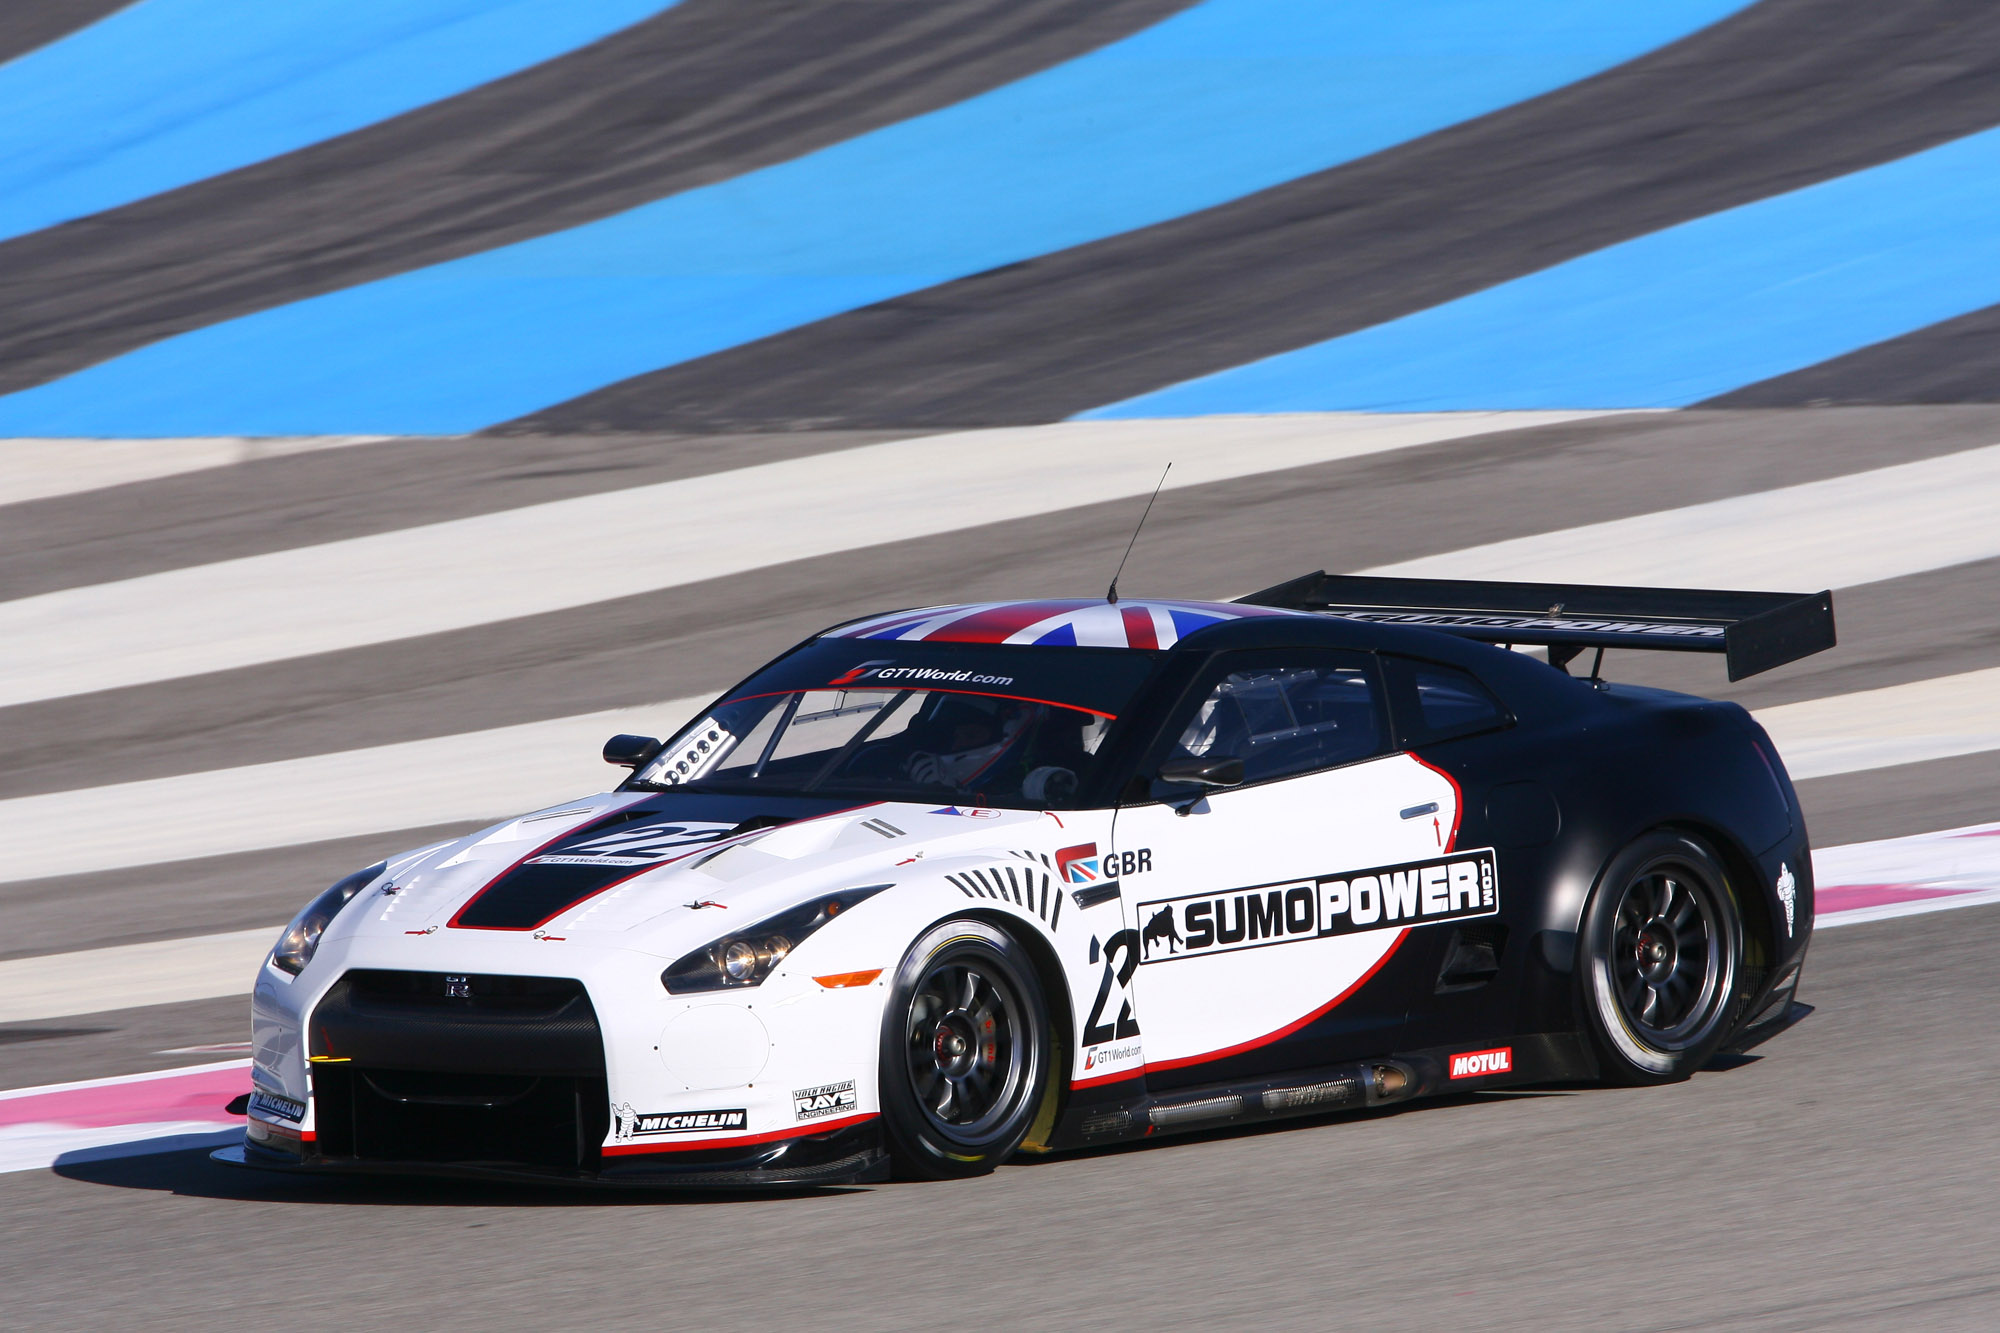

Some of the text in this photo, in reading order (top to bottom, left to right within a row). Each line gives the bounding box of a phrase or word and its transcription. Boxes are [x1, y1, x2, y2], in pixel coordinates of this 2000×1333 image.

[878, 668, 1013, 686] GT1World.com
[546, 826, 732, 858] 22
[1103, 848, 1152, 879] GBR
[1081, 928, 1141, 1048] 22
[1098, 1046, 1142, 1064] GT1World.com
[1452, 1051, 1509, 1076] MOTUL
[259, 1093, 305, 1118] MICHELIN
[797, 1091, 855, 1113] RAYS
[798, 1104, 856, 1120] ENGINEERING
[640, 1112, 744, 1131] MICHELIN
